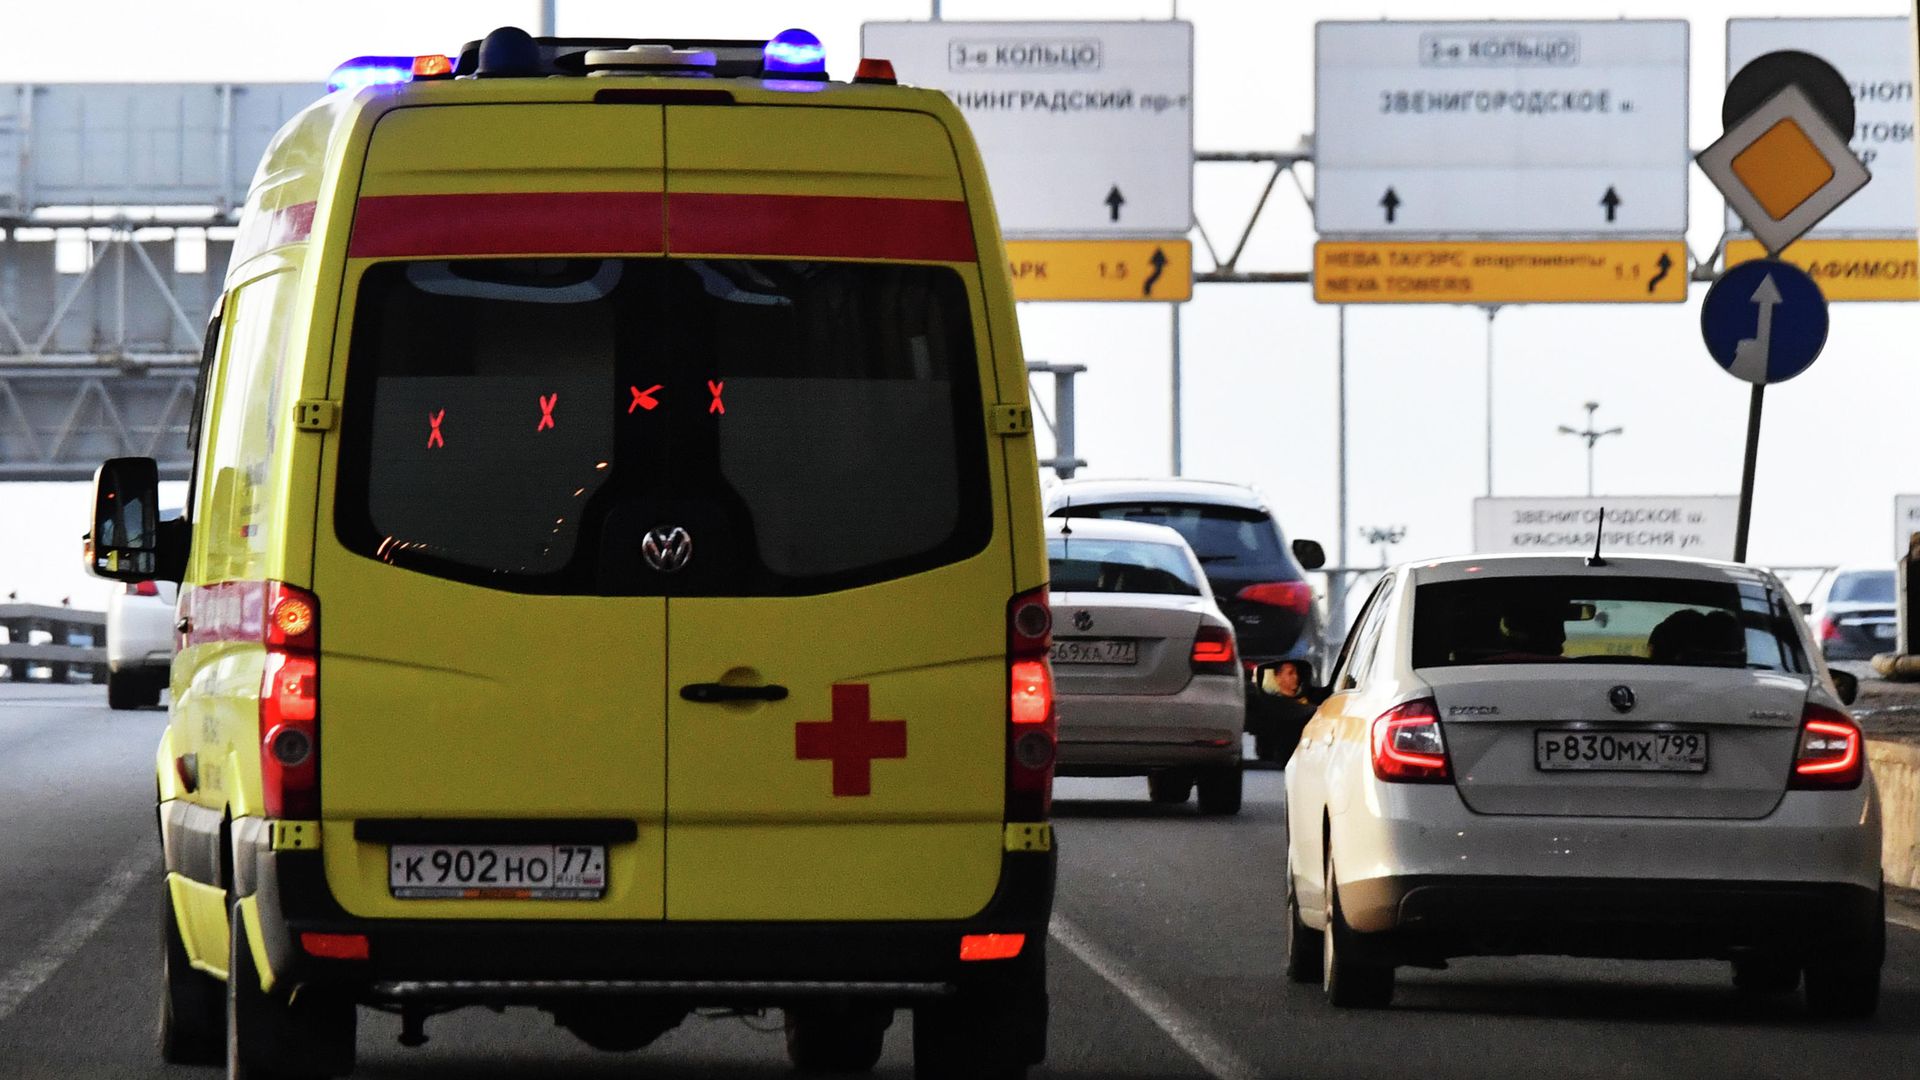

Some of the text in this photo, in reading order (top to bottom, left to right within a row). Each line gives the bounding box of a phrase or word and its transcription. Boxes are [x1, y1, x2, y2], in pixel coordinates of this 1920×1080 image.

[995, 45, 1096, 67] КОЛЬЦО
[1380, 88, 1612, 114] ЗВЕНИГОРОДСКОЕ
[1658, 734, 1699, 755] 799
[559, 847, 592, 873] 77
